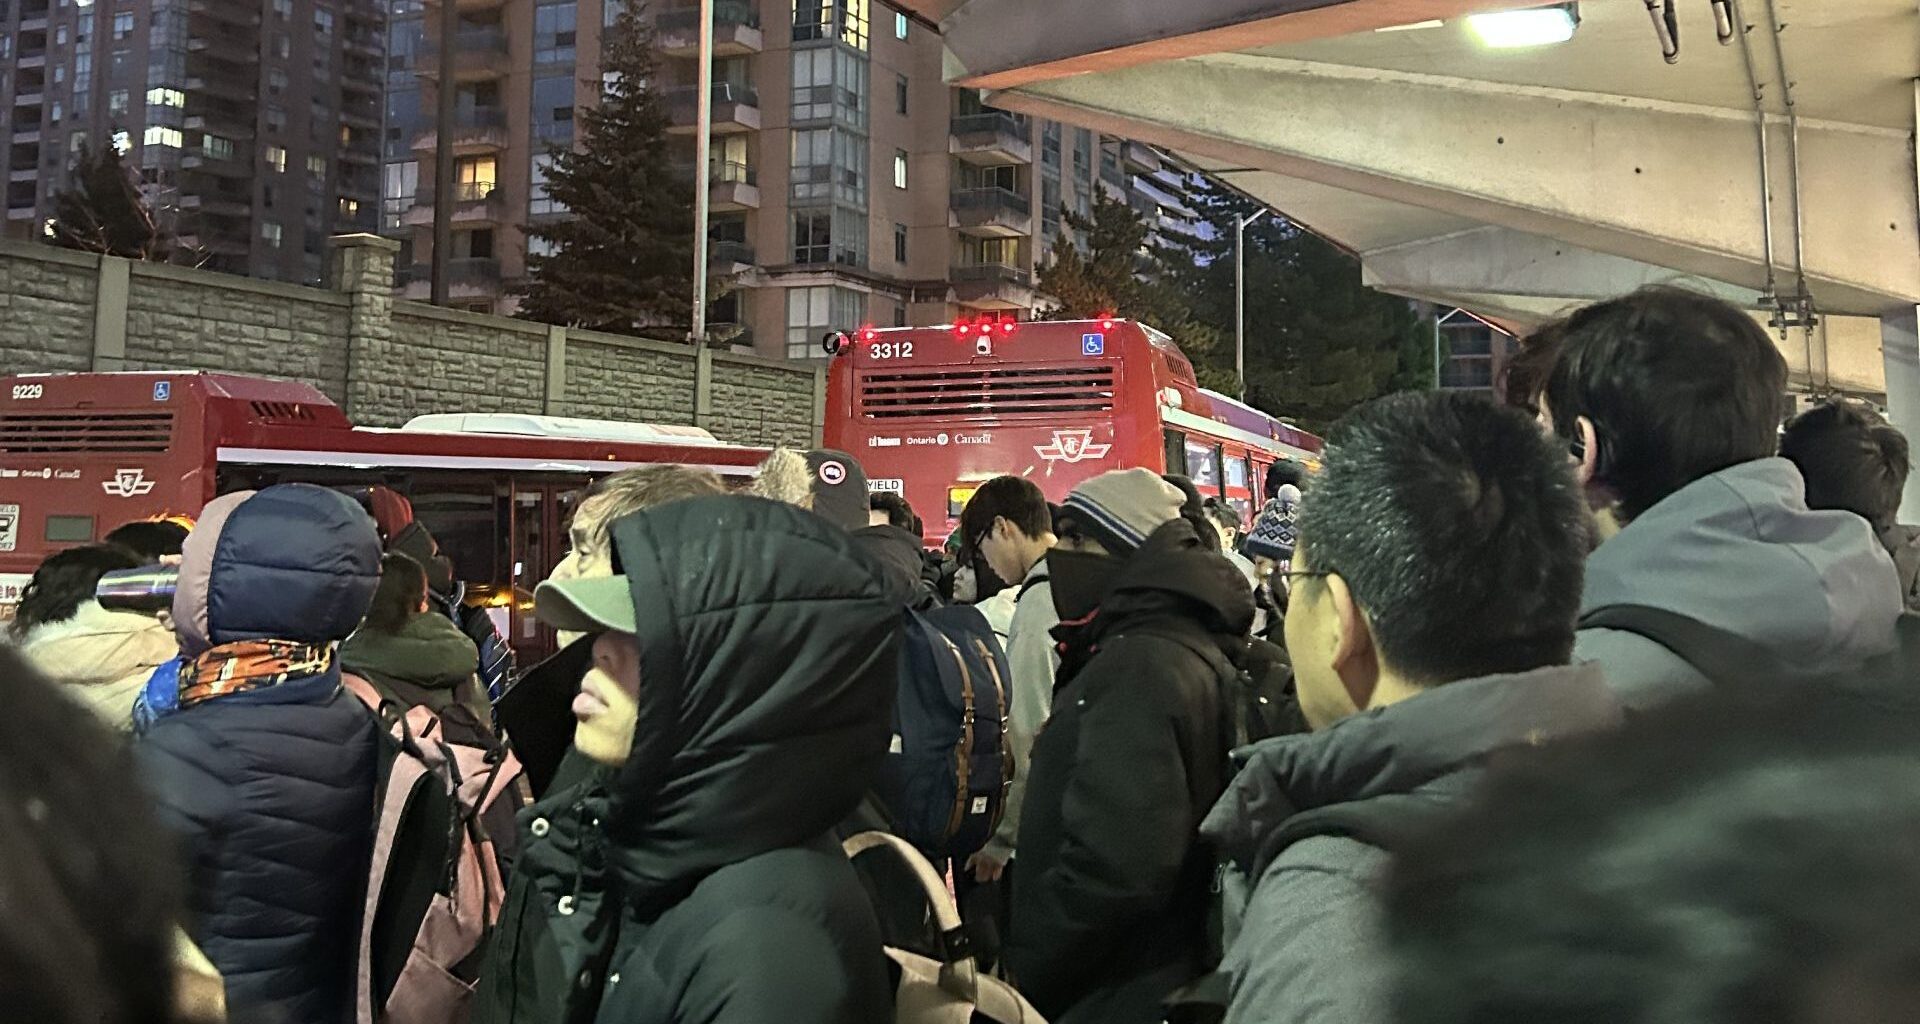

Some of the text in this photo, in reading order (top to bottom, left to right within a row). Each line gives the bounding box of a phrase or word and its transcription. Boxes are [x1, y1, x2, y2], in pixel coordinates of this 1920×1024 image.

[870, 341, 913, 359] 3312
[12, 384, 43, 399] 9229
[906, 436, 936, 445] Ontario
[954, 433, 992, 445] Canada
[867, 480, 899, 489] YIELD
